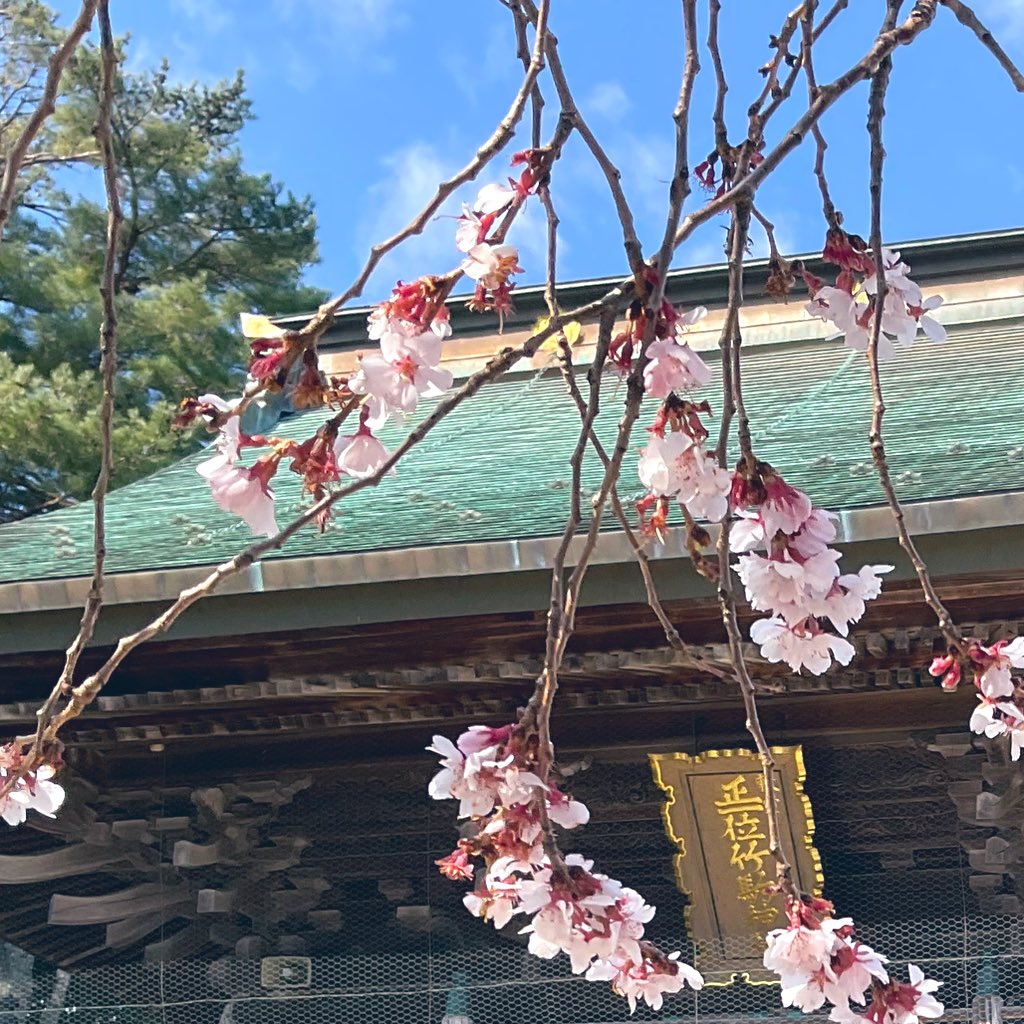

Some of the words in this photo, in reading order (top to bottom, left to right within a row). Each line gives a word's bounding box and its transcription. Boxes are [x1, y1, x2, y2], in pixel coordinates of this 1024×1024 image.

[713, 774, 780, 952] 正一位竹駒
